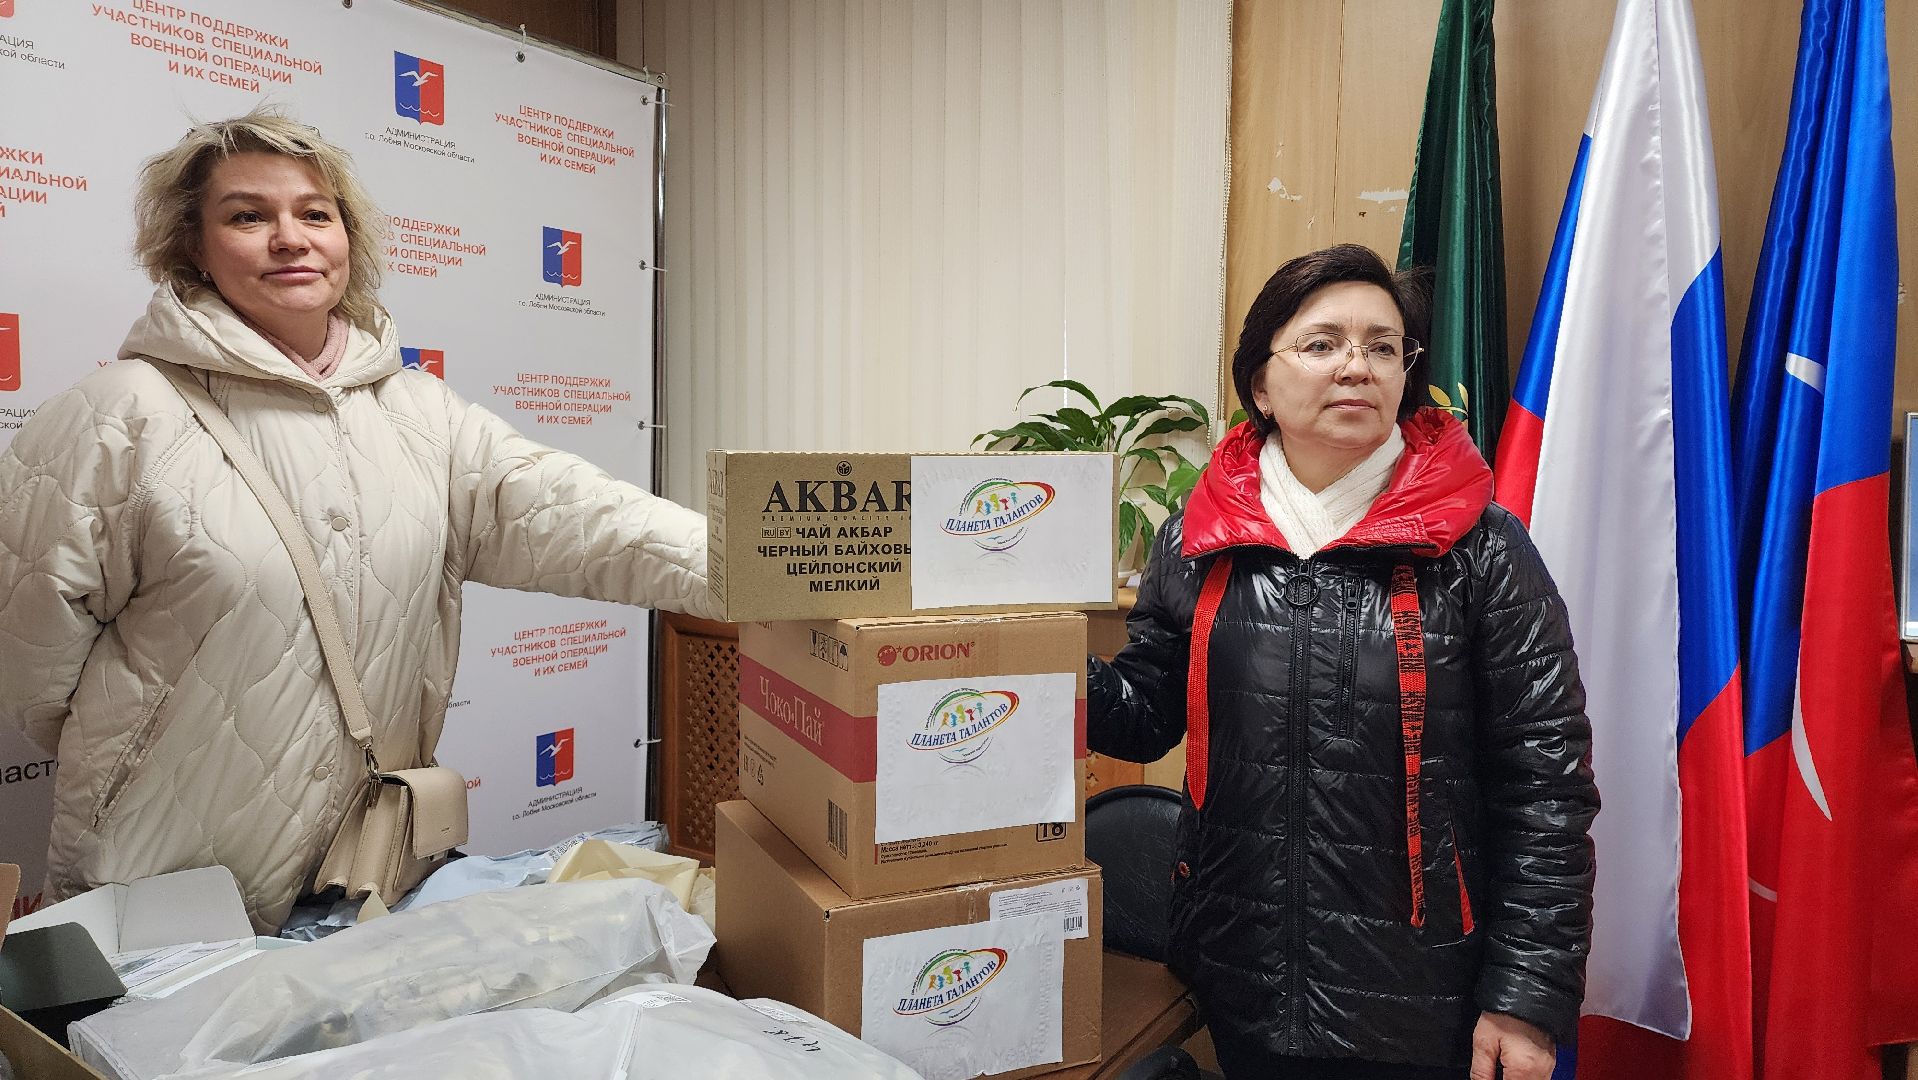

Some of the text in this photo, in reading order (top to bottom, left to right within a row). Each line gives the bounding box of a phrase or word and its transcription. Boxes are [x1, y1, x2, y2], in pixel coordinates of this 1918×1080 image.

[132, 0, 289, 50] ЦЕНТР ПОДДЕРЖКИ
[91, 3, 323, 75] УЧАСТНИКОВ СПЕЦИАЛЬНОЙ
[20, 53, 65, 70] области
[130, 33, 293, 84] ВОЕННОЙ ОПЕРАЦИИ
[168, 60, 260, 93] И ИХ СЕМЕЙ
[519, 104, 614, 139] ЦЕНТР ПОДДЕРЖКИ
[385, 126, 456, 149] АДМИНИСТРАЦИЯ
[494, 112, 635, 157] УЧАСТНИКОВ СПЕЦИАЛЬНОЙ
[446, 151, 475, 164] области
[517, 132, 616, 166] ВОЕННОЙ ОПЕРАЦИИ
[540, 153, 596, 175] И ИХ СЕМЕЙ
[400, 233, 487, 256] СПЕЦИАЛЬНОЙ
[401, 248, 463, 267] ОПЕРАЦИИ
[397, 262, 438, 278] СЕМЕЙ
[535, 293, 591, 306] АДМИНИСТРАЦИЯ
[517, 372, 611, 389] ЦЕНТР ПОДДЕРЖКИ
[493, 384, 632, 403] УЧАСТНИКОВ СПЕЦИАЛЬНОЙ
[515, 397, 612, 415] ВОЕННОЙ ОПЕРАЦИИ
[537, 413, 593, 426] И ИХ СЕМЕЙ
[761, 480, 911, 513] AKBAR
[945, 518, 991, 532] ПЛАНЕТА
[993, 494, 1044, 528] ТАЛАНТОВ
[795, 523, 831, 538] ЧАЙ
[836, 526, 893, 539] АКБАР
[757, 541, 828, 557] ЧЕРНЫЙ
[786, 557, 902, 576] ЦЕЙЛОНСКИЙ
[809, 575, 880, 592] МЕЛКИЙ
[514, 619, 607, 642] ЦЕНТР ПОДДЕРЖКИ
[490, 627, 626, 658] УЧАСТНИКОВ СПЕЦИАЛЬНОЙ
[902, 642, 970, 663] ORION
[512, 644, 608, 668] ВОЕННОЙ ОПЕРАЦИИ
[534, 659, 588, 677] И ИХ СЕМЕЙ
[446, 699, 471, 709] бласти
[910, 731, 957, 747] ПЛАНЕТА
[958, 703, 1009, 740] ТАЛАНТОВ
[528, 786, 583, 808] АДМИНИСТРАЦИЯ
[1041, 822, 1065, 839] 18
[897, 993, 944, 1012] ПЛАНЕТА
[945, 960, 997, 1001] ТАЛАНТОВ
